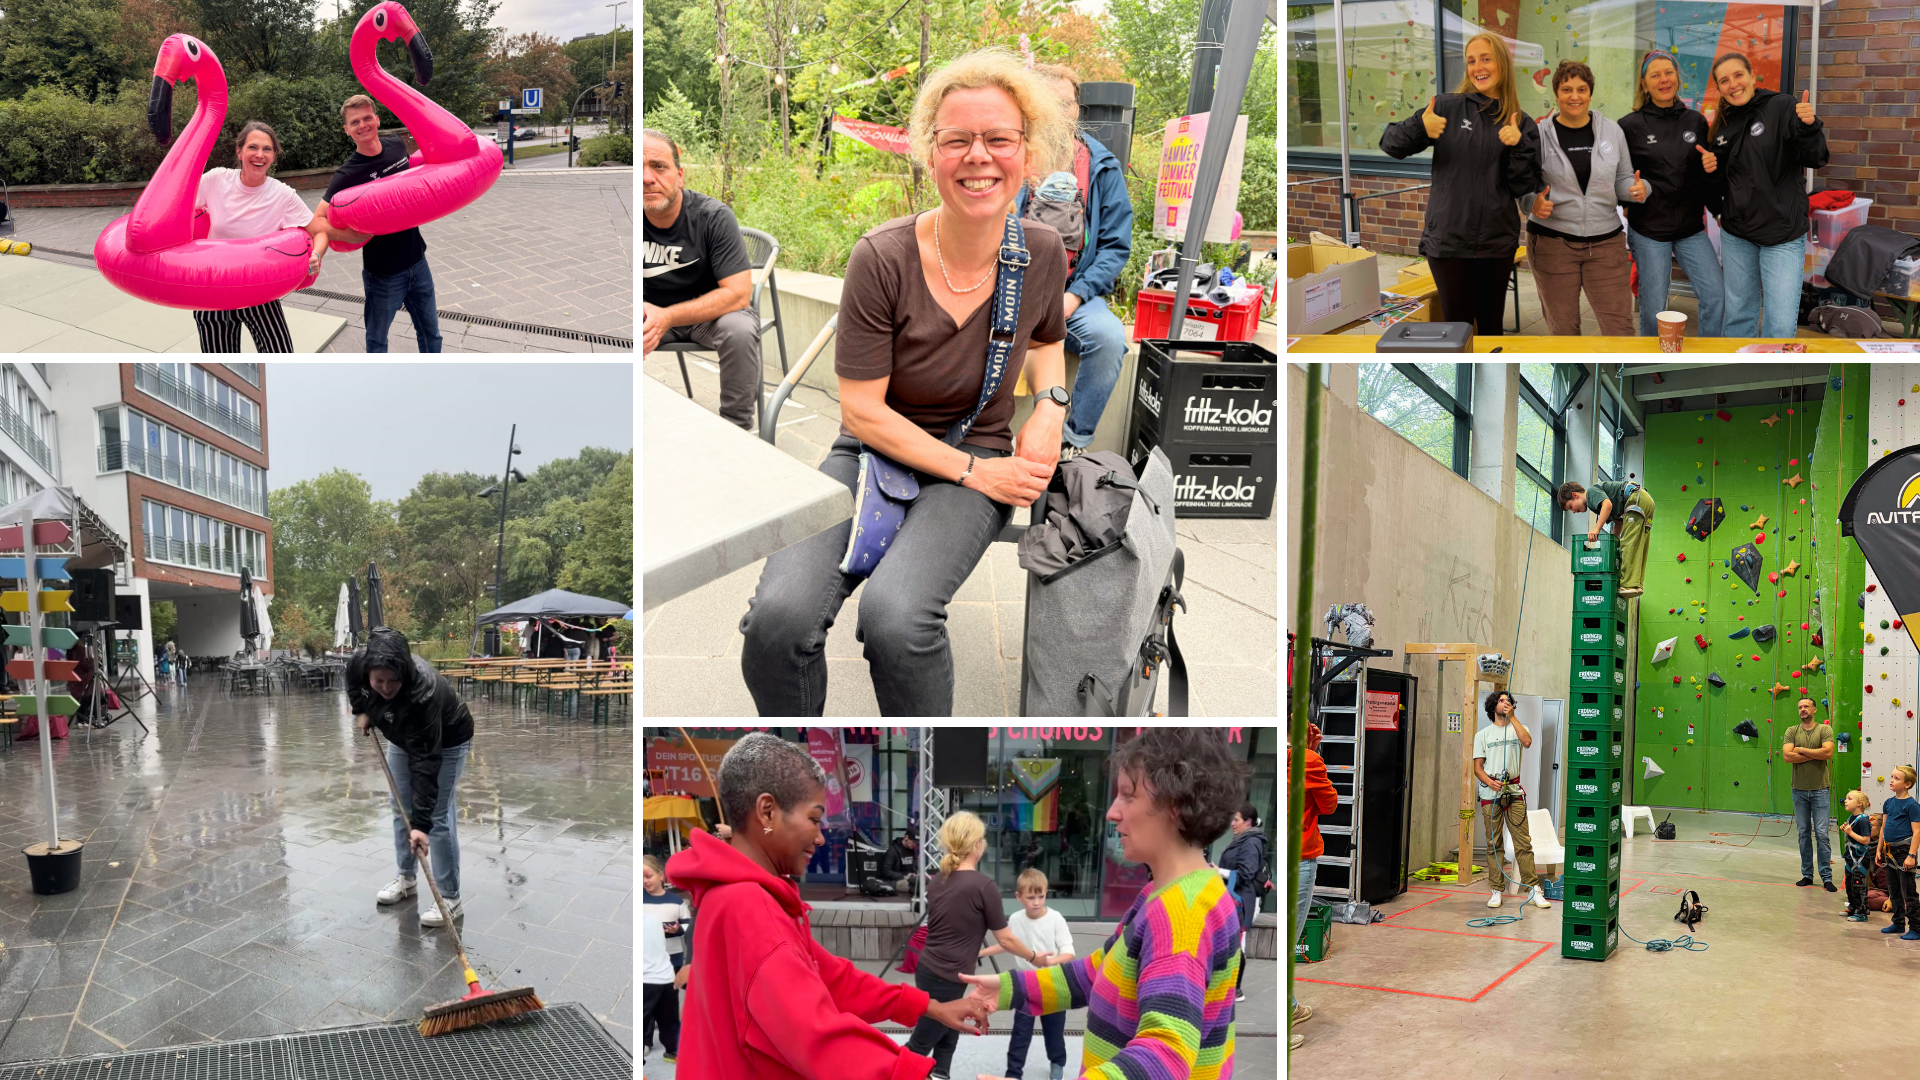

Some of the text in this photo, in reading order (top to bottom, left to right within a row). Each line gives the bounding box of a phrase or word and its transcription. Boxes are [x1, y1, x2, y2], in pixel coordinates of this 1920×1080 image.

[526, 91, 538, 106] U
[1163, 143, 1200, 162] HAMMER
[1160, 163, 1196, 181] SOMMER
[1158, 182, 1193, 199] FESTIVAL
[643, 241, 683, 265] NIKE
[1004, 279, 1017, 321] MOIN
[1183, 328, 1204, 338] 7064
[1184, 396, 1272, 426] fritz-kola
[1174, 475, 1256, 500] fritz-kola
[655, 752, 723, 762] DEIN SPOTLICH
[847, 766, 858, 776] T16
